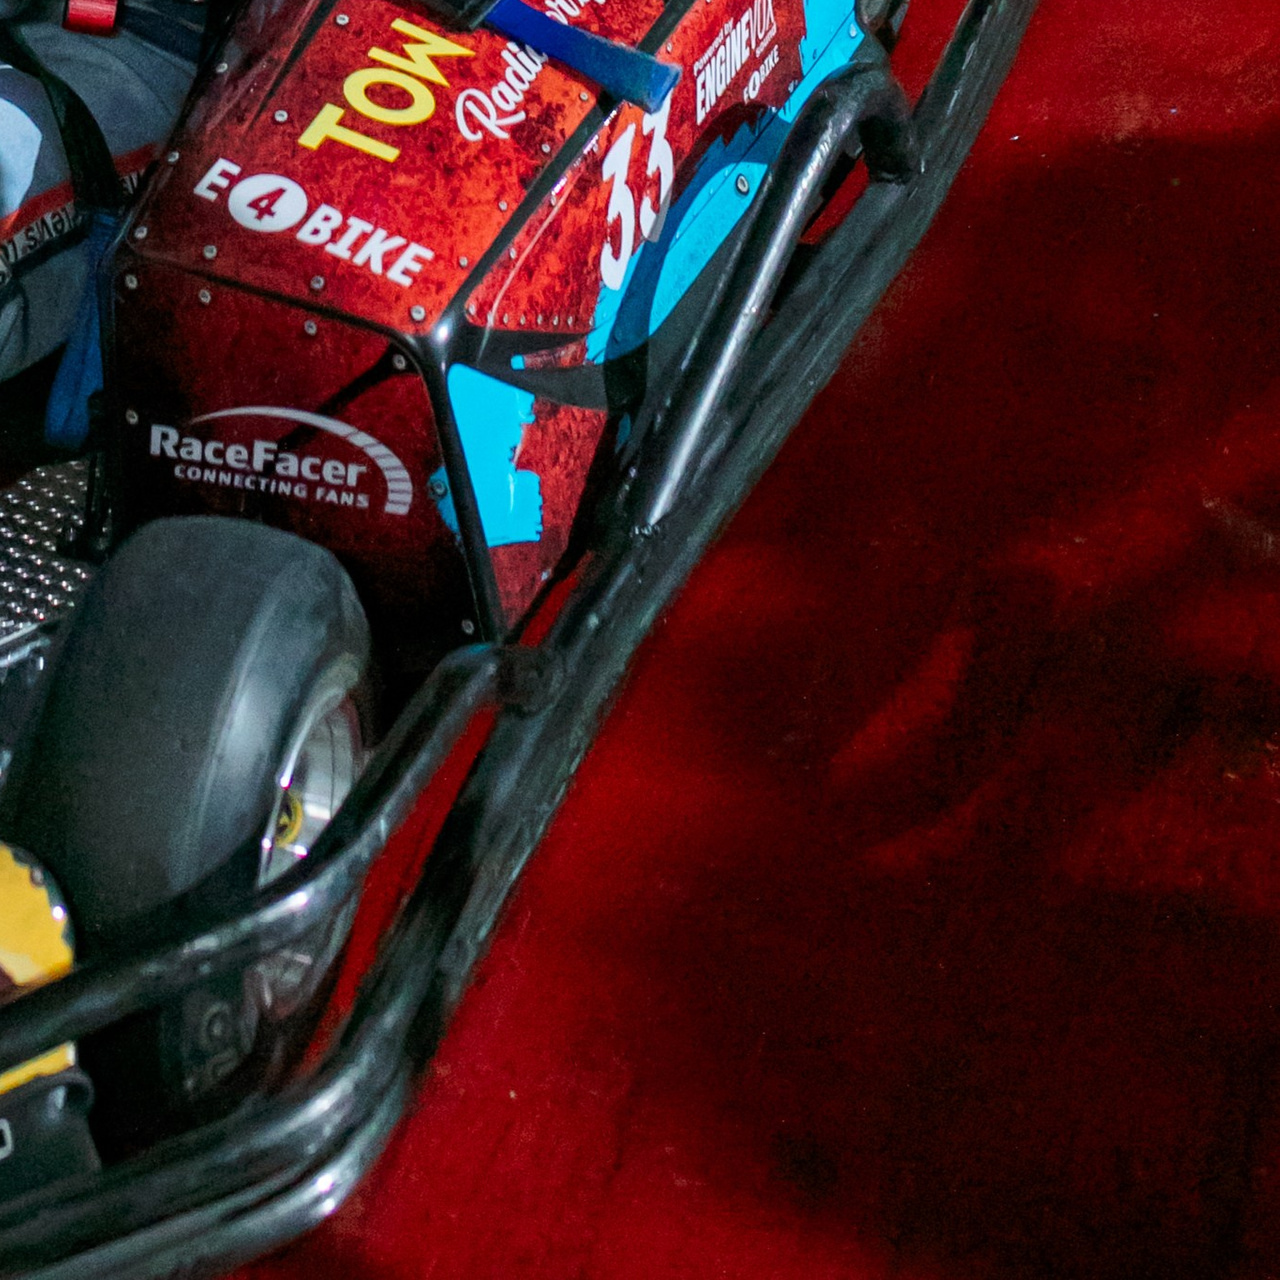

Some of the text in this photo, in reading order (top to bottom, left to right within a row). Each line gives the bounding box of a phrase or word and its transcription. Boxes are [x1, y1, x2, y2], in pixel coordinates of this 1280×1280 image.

[298, 18, 475, 163] TOW
[600, 88, 673, 291] 33
[150, 424, 367, 487] RaceFacer
[174, 464, 369, 508] CONNECTING FANS
